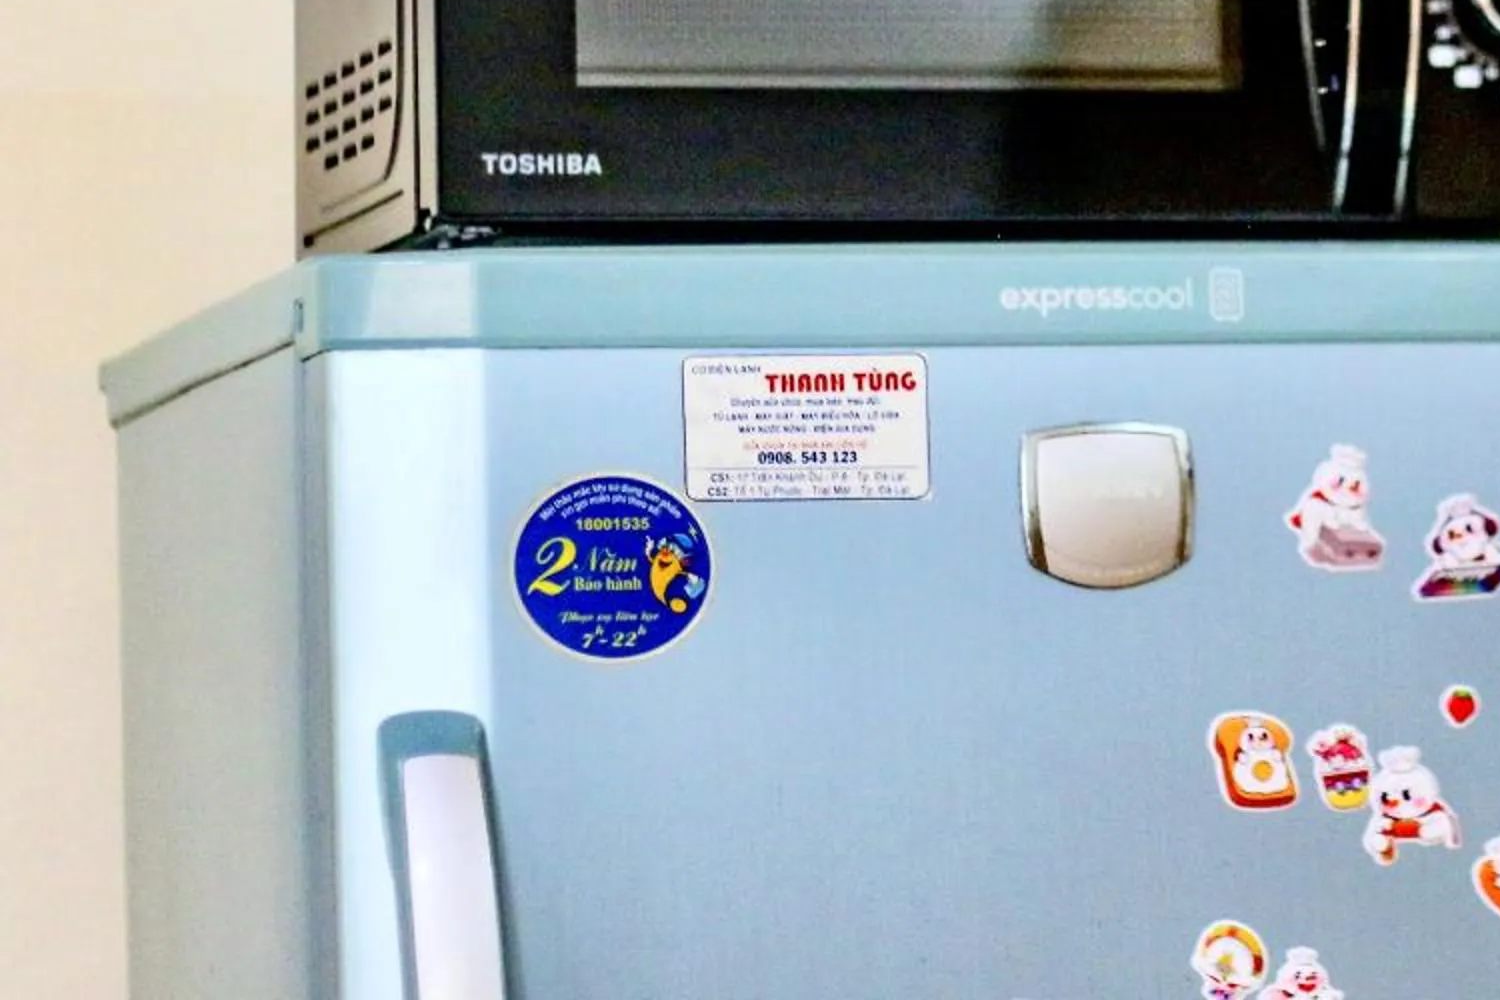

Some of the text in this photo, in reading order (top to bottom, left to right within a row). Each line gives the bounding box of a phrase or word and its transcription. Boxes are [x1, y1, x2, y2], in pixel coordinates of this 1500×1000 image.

[481, 152, 602, 176] TOSHIBA
[1000, 277, 1194, 318] expresscool
[764, 367, 917, 393] THANH TÙNG
[801, 451, 827, 464] 543
[833, 451, 858, 463] 123
[575, 517, 650, 531] 18001535
[528, 536, 577, 597] 2
